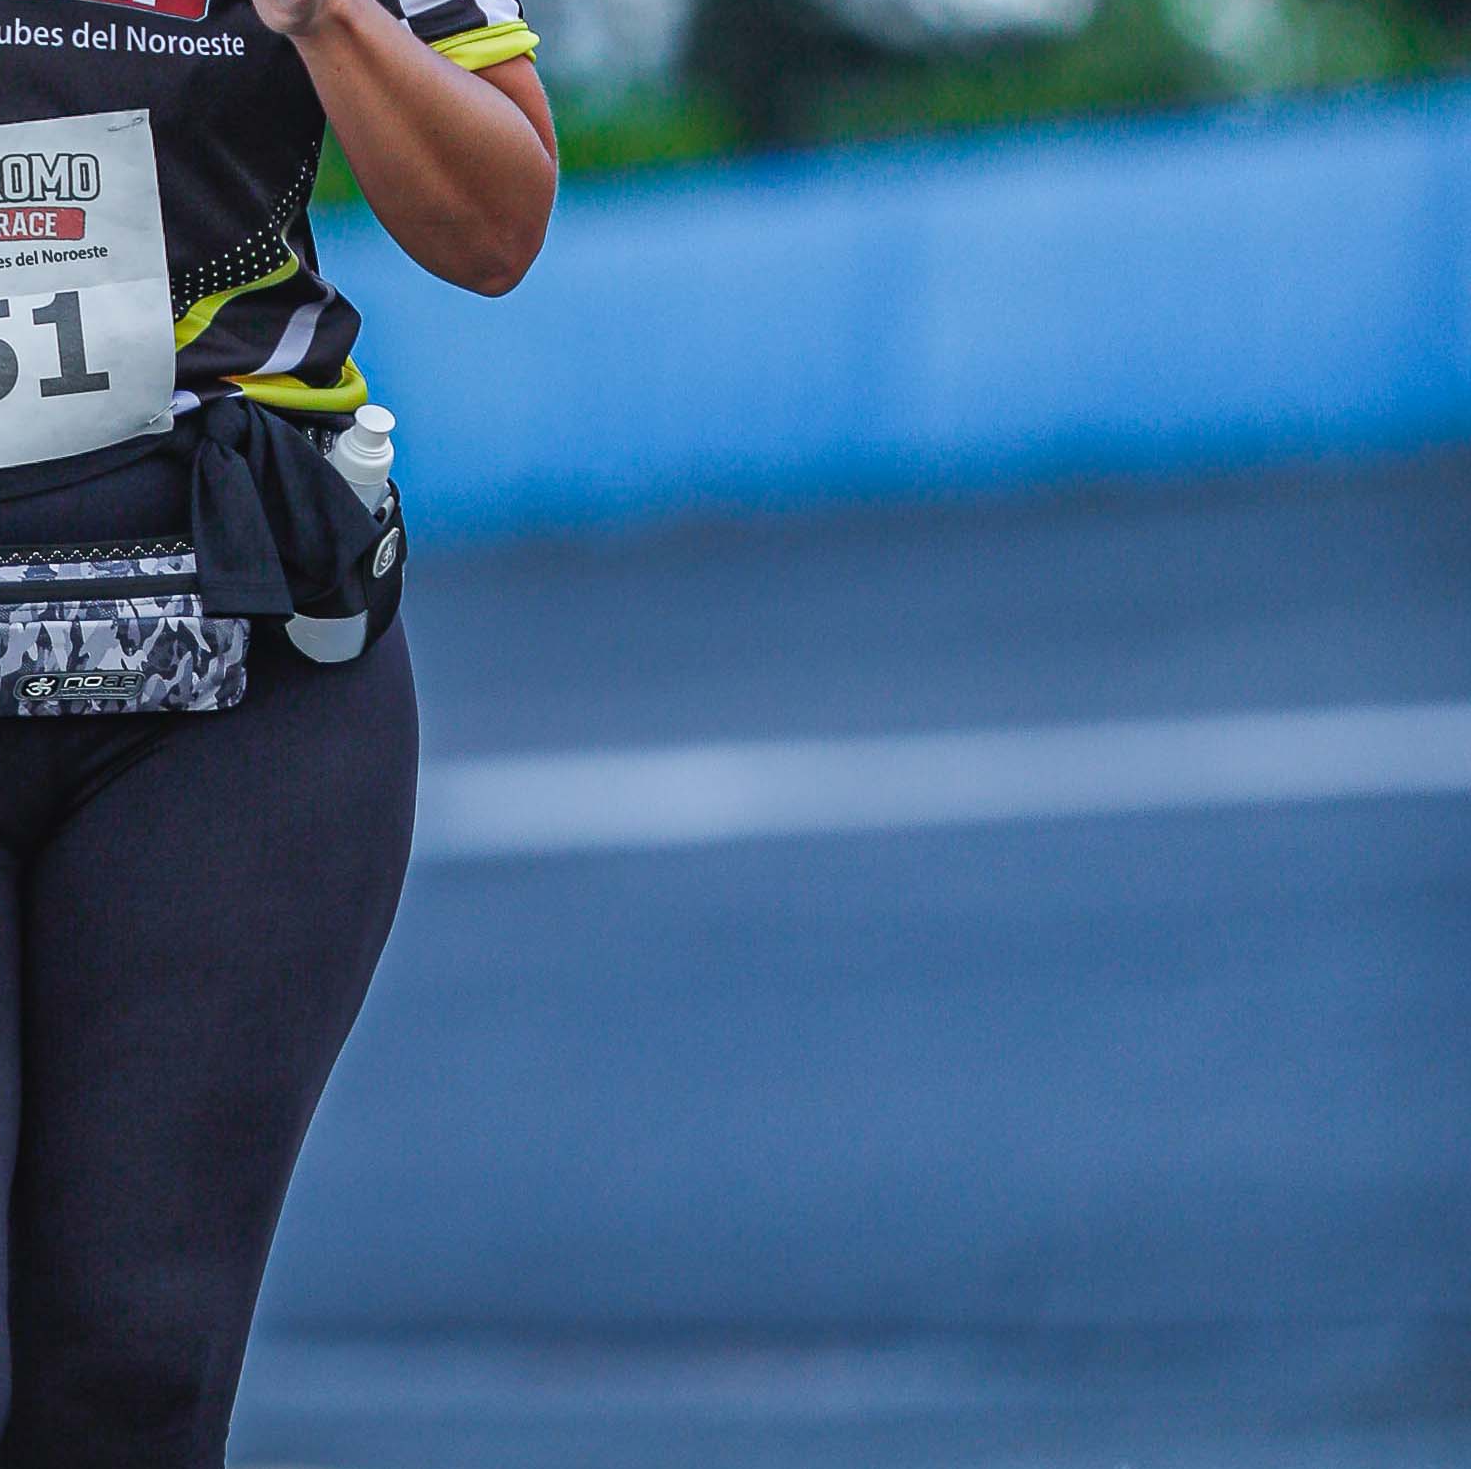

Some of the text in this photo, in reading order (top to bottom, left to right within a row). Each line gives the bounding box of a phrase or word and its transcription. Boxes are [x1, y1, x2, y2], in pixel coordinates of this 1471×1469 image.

[71, 21, 116, 51] del
[127, 25, 245, 56] Noroeste
[15, 250, 39, 268] del
[42, 245, 109, 264] Noroeste
